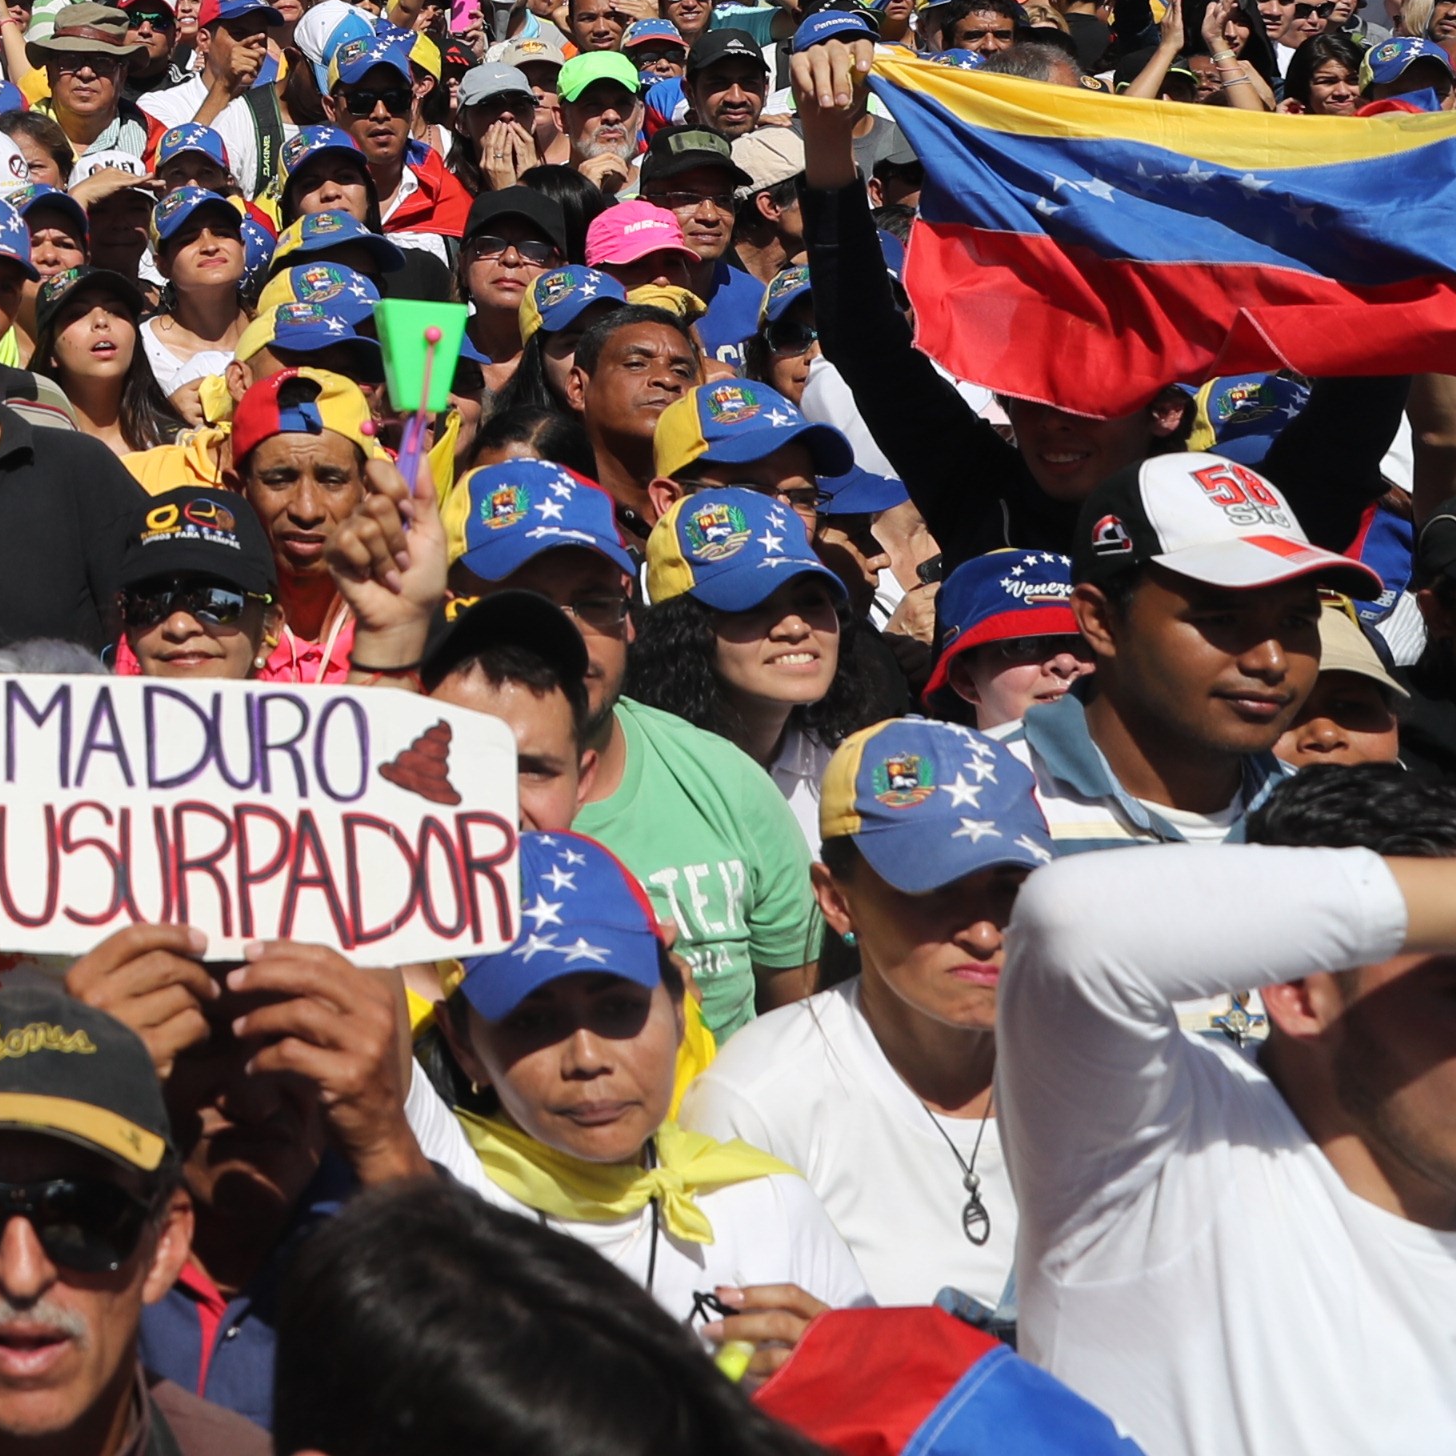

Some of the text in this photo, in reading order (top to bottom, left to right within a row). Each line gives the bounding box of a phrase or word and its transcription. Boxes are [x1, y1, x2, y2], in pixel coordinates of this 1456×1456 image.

[813, 17, 863, 32] Panasonic
[263, 134, 271, 178] DAKINE
[1188, 462, 1280, 509] 58
[175, 531, 201, 540] PARA
[203, 533, 241, 550] SIEMPRE
[1013, 580, 1073, 597] Venezu
[5, 680, 369, 802] MADURO
